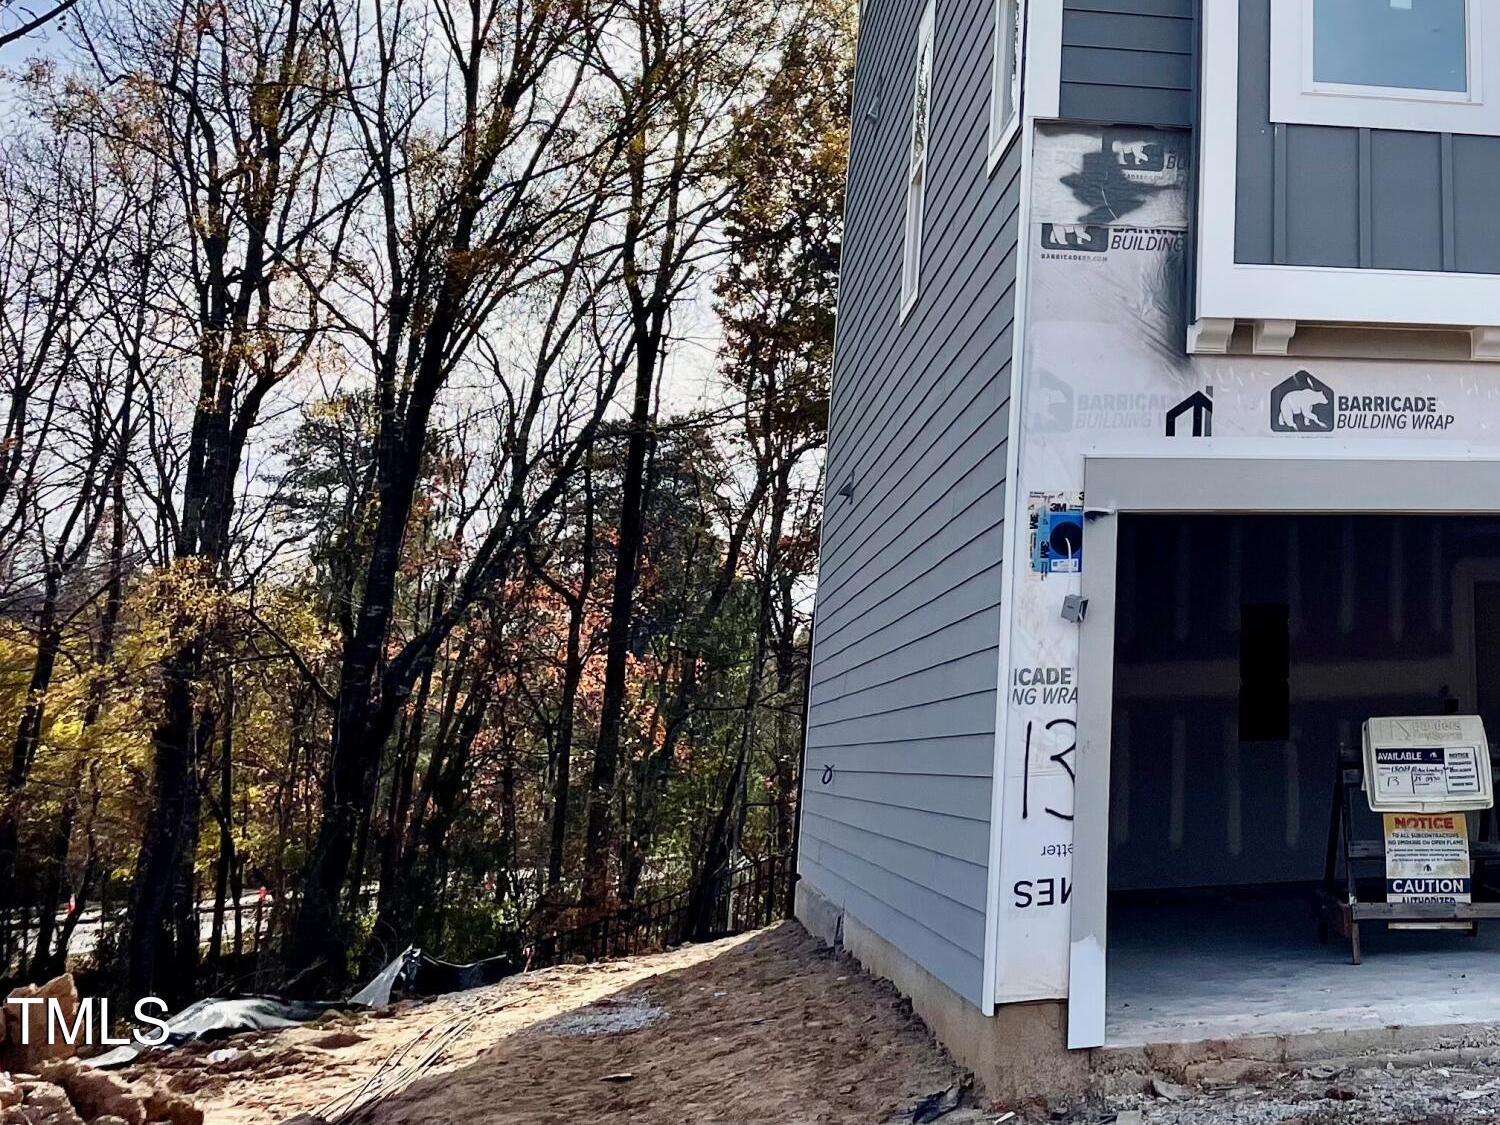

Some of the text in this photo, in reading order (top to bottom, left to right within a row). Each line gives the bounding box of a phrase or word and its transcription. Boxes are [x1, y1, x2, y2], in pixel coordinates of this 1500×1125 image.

[1110, 234, 1185, 253] BUILDING
[1338, 396, 1437, 413] BARRICADE
[1336, 413, 1455, 431] BUILDING WRAP
[1049, 502, 1067, 513] 3M
[1040, 540, 1050, 559] 3M
[1012, 687, 1078, 706] NG WRA
[1377, 751, 1423, 761] AVAILABLE
[1022, 718, 1077, 821] 13
[1394, 817, 1454, 829] NOTICE
[1392, 879, 1464, 893] CAUTION
